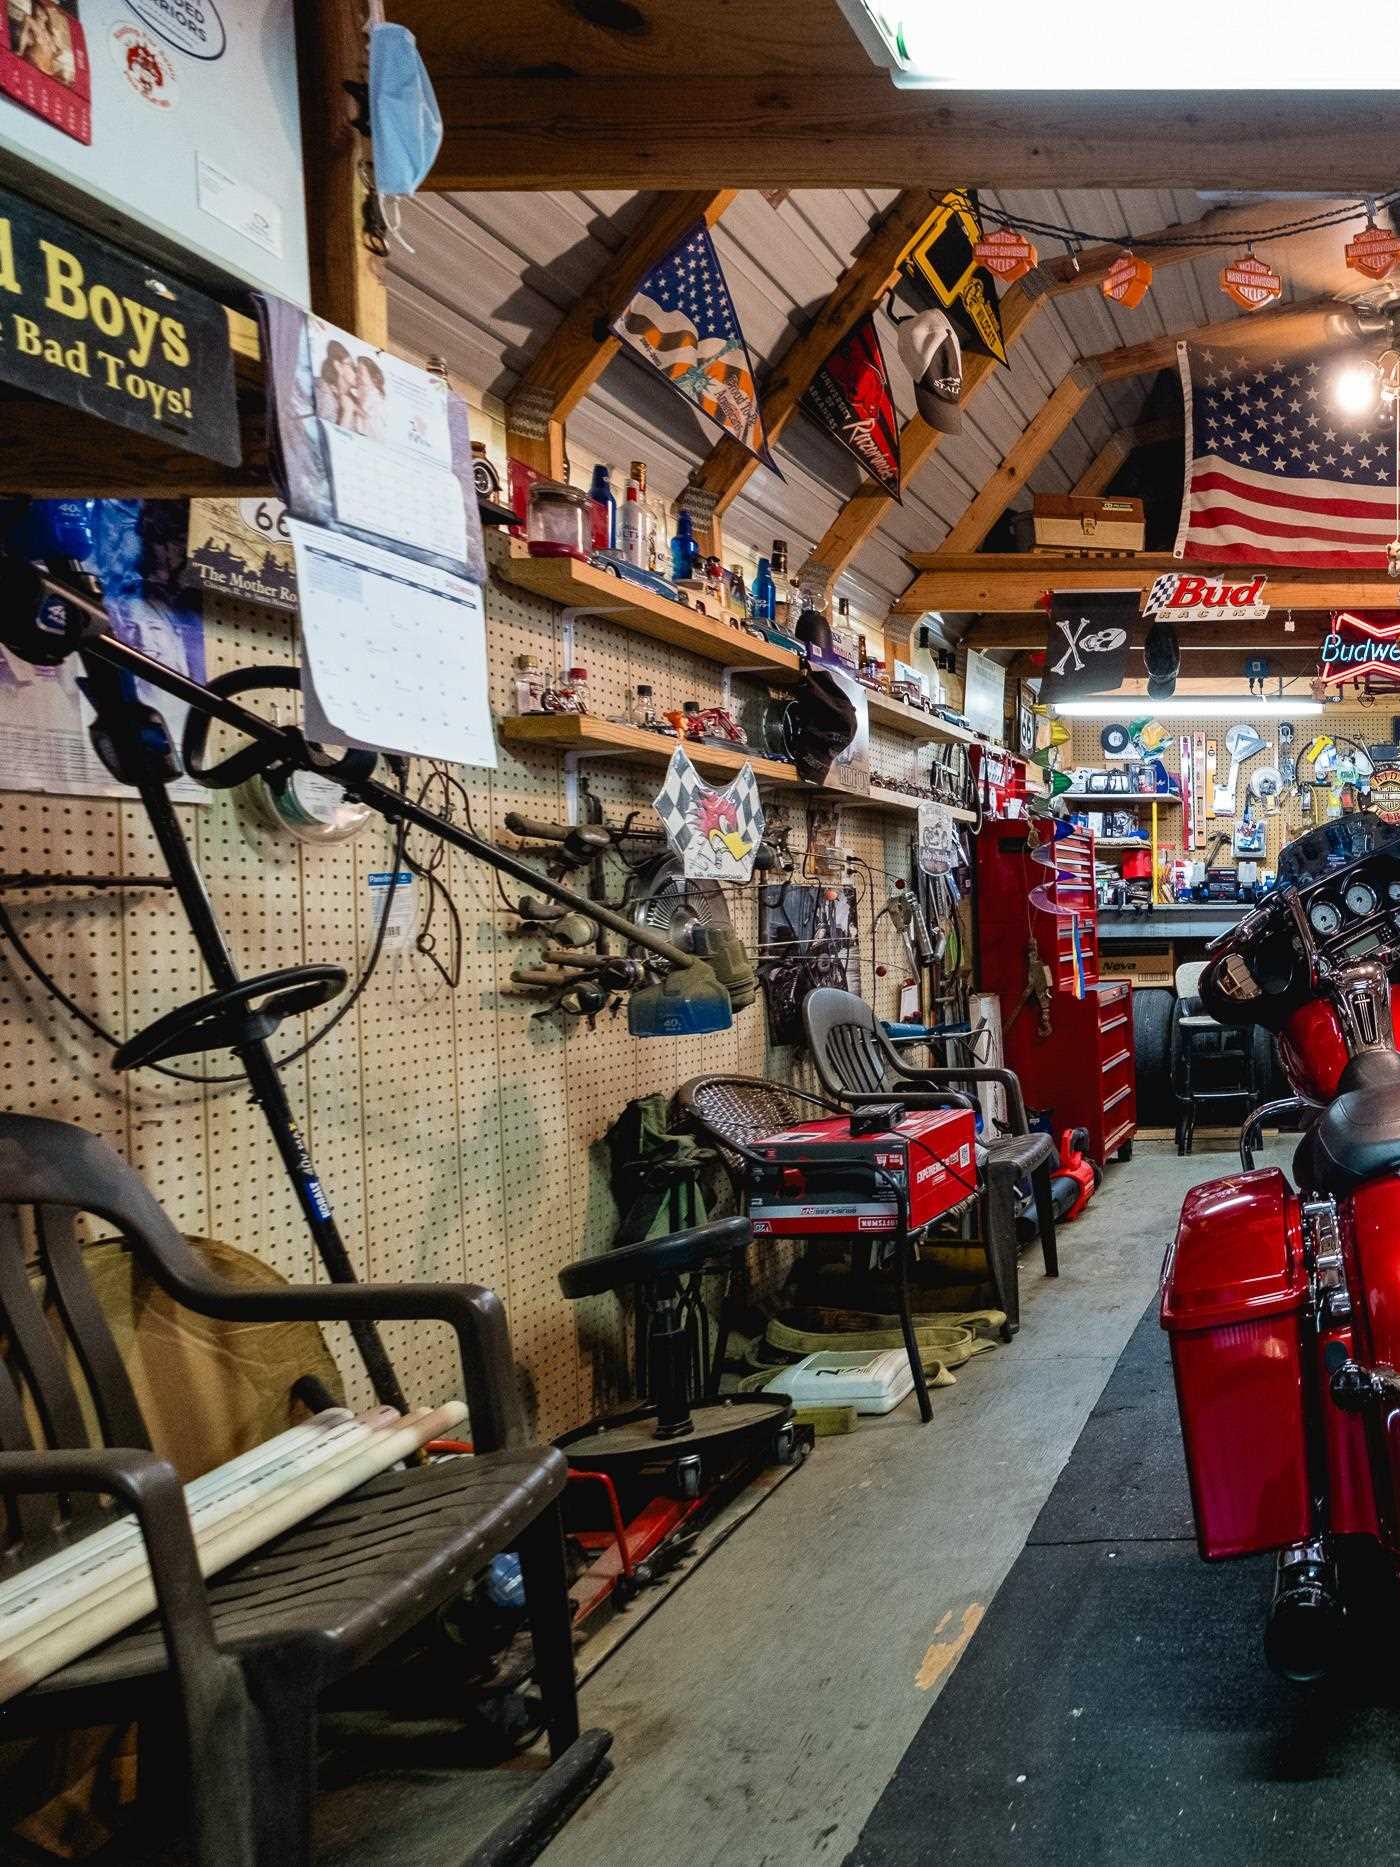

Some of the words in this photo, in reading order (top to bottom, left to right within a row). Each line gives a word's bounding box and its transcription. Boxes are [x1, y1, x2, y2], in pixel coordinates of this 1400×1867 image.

[975, 245, 1029, 257] HARLEY-DAVIDSON
[1349, 240, 1400, 256] HARLEY-DAVIDSON
[1226, 271, 1280, 289] HARLEY-DAVIDSON
[38, 238, 191, 369] Boys
[12, 313, 92, 378] Bad
[97, 350, 193, 420] Toys!
[842, 418, 894, 482] Razorbacks
[230, 573, 277, 597] Mother
[280, 589, 297, 602] Ro
[1166, 575, 1267, 608] Bud
[1158, 608, 1267, 620] RACING
[308, 1181, 332, 1219] KOBALT
